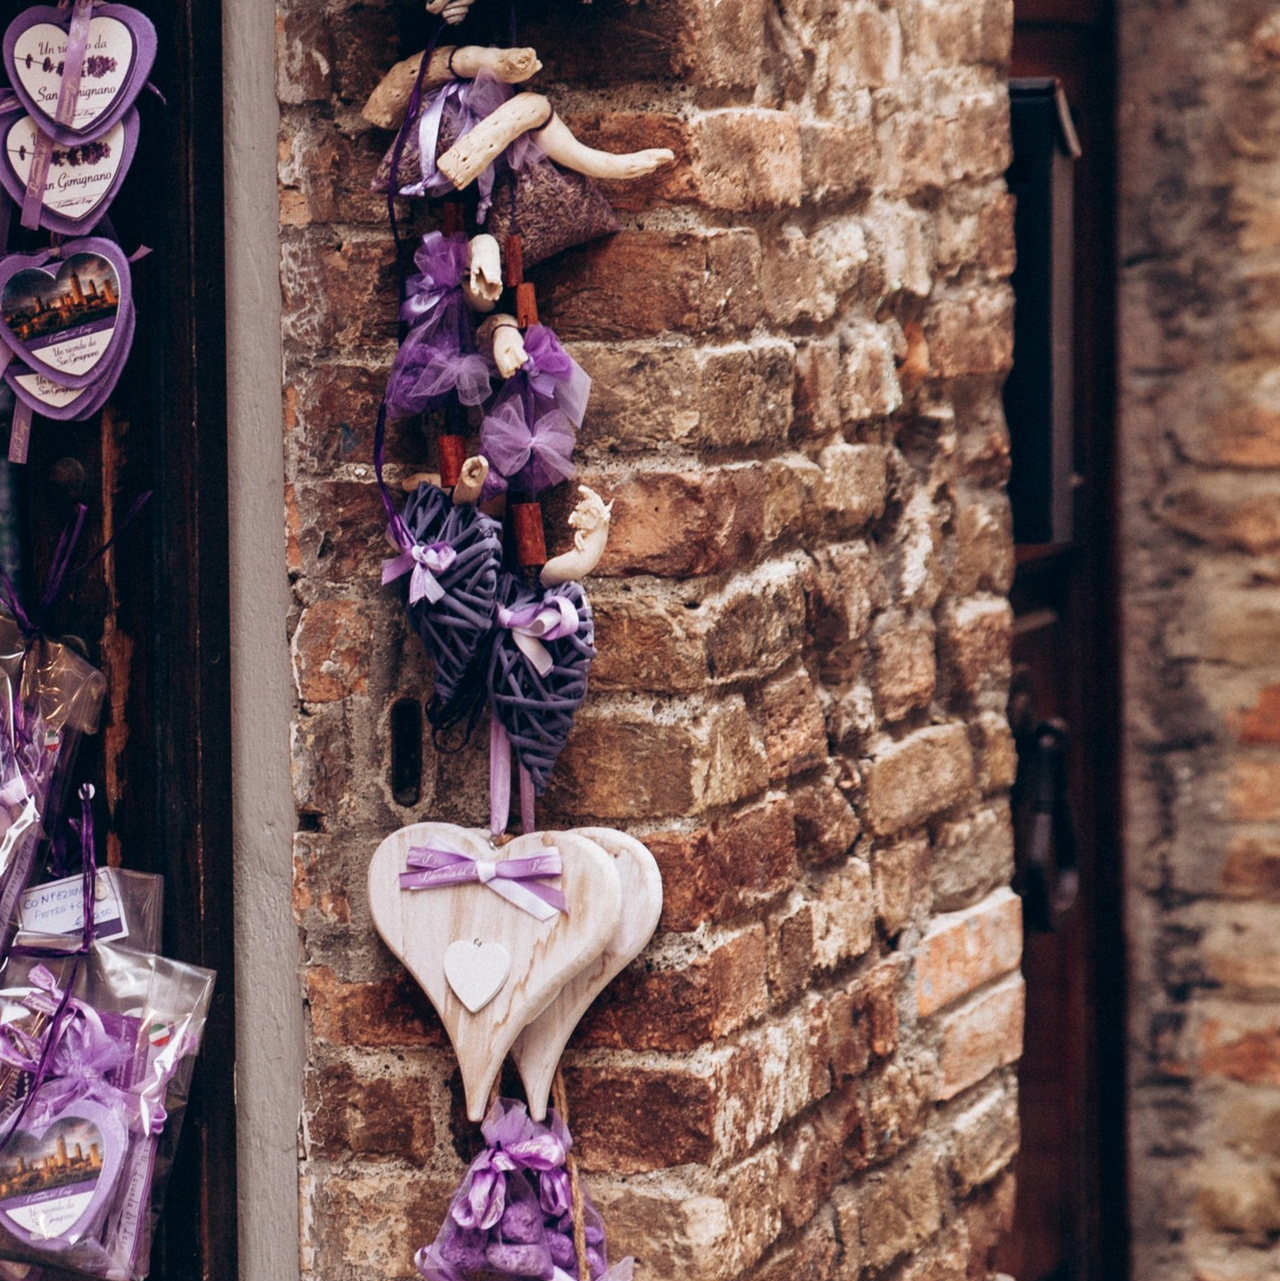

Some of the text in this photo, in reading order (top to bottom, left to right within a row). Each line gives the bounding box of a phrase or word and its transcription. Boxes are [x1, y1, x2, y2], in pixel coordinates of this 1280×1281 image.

[38, 41, 55, 55] Un
[94, 35, 107, 49] da
[37, 86, 58, 102] San
[57, 172, 112, 192] Gimignano
